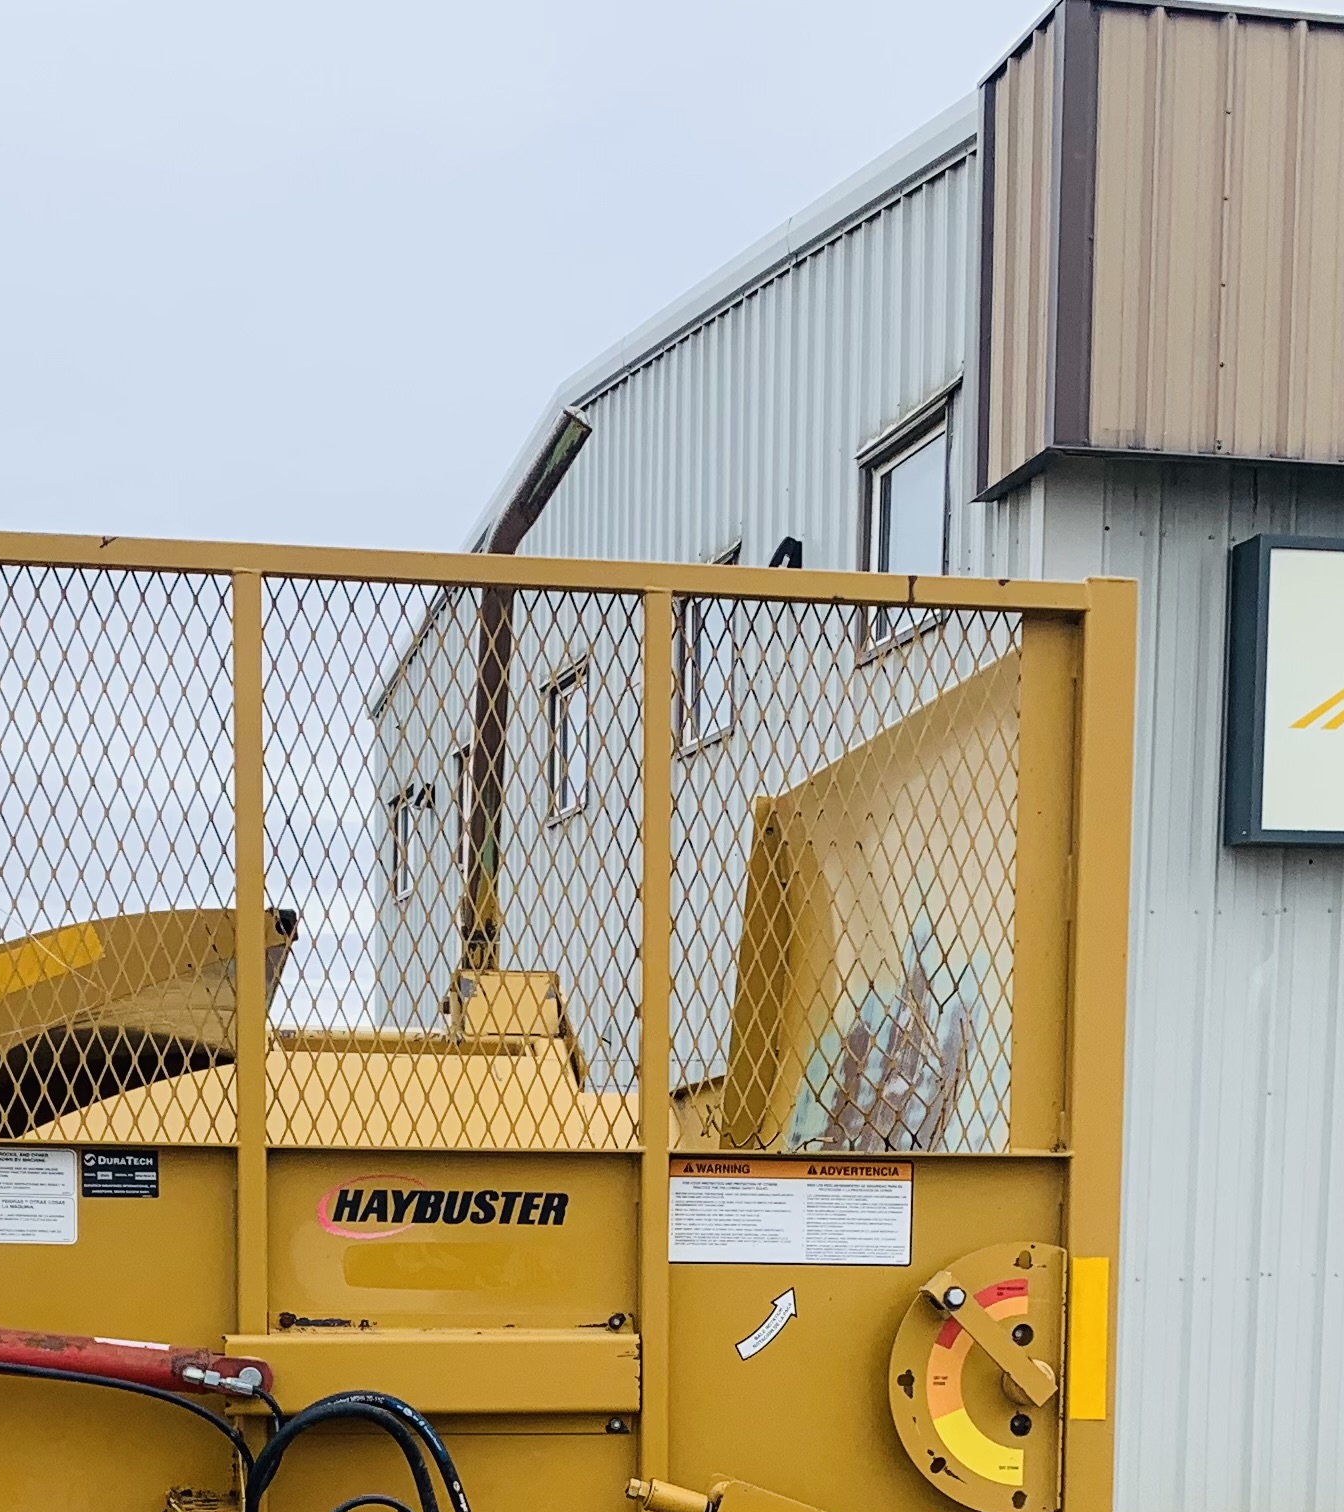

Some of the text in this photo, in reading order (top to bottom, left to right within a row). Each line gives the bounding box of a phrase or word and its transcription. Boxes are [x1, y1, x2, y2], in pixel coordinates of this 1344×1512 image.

[696, 1162, 751, 1174] WARNING
[819, 1165, 900, 1177] ADVERTENCIA
[332, 1189, 569, 1226] HAYBUSTER
